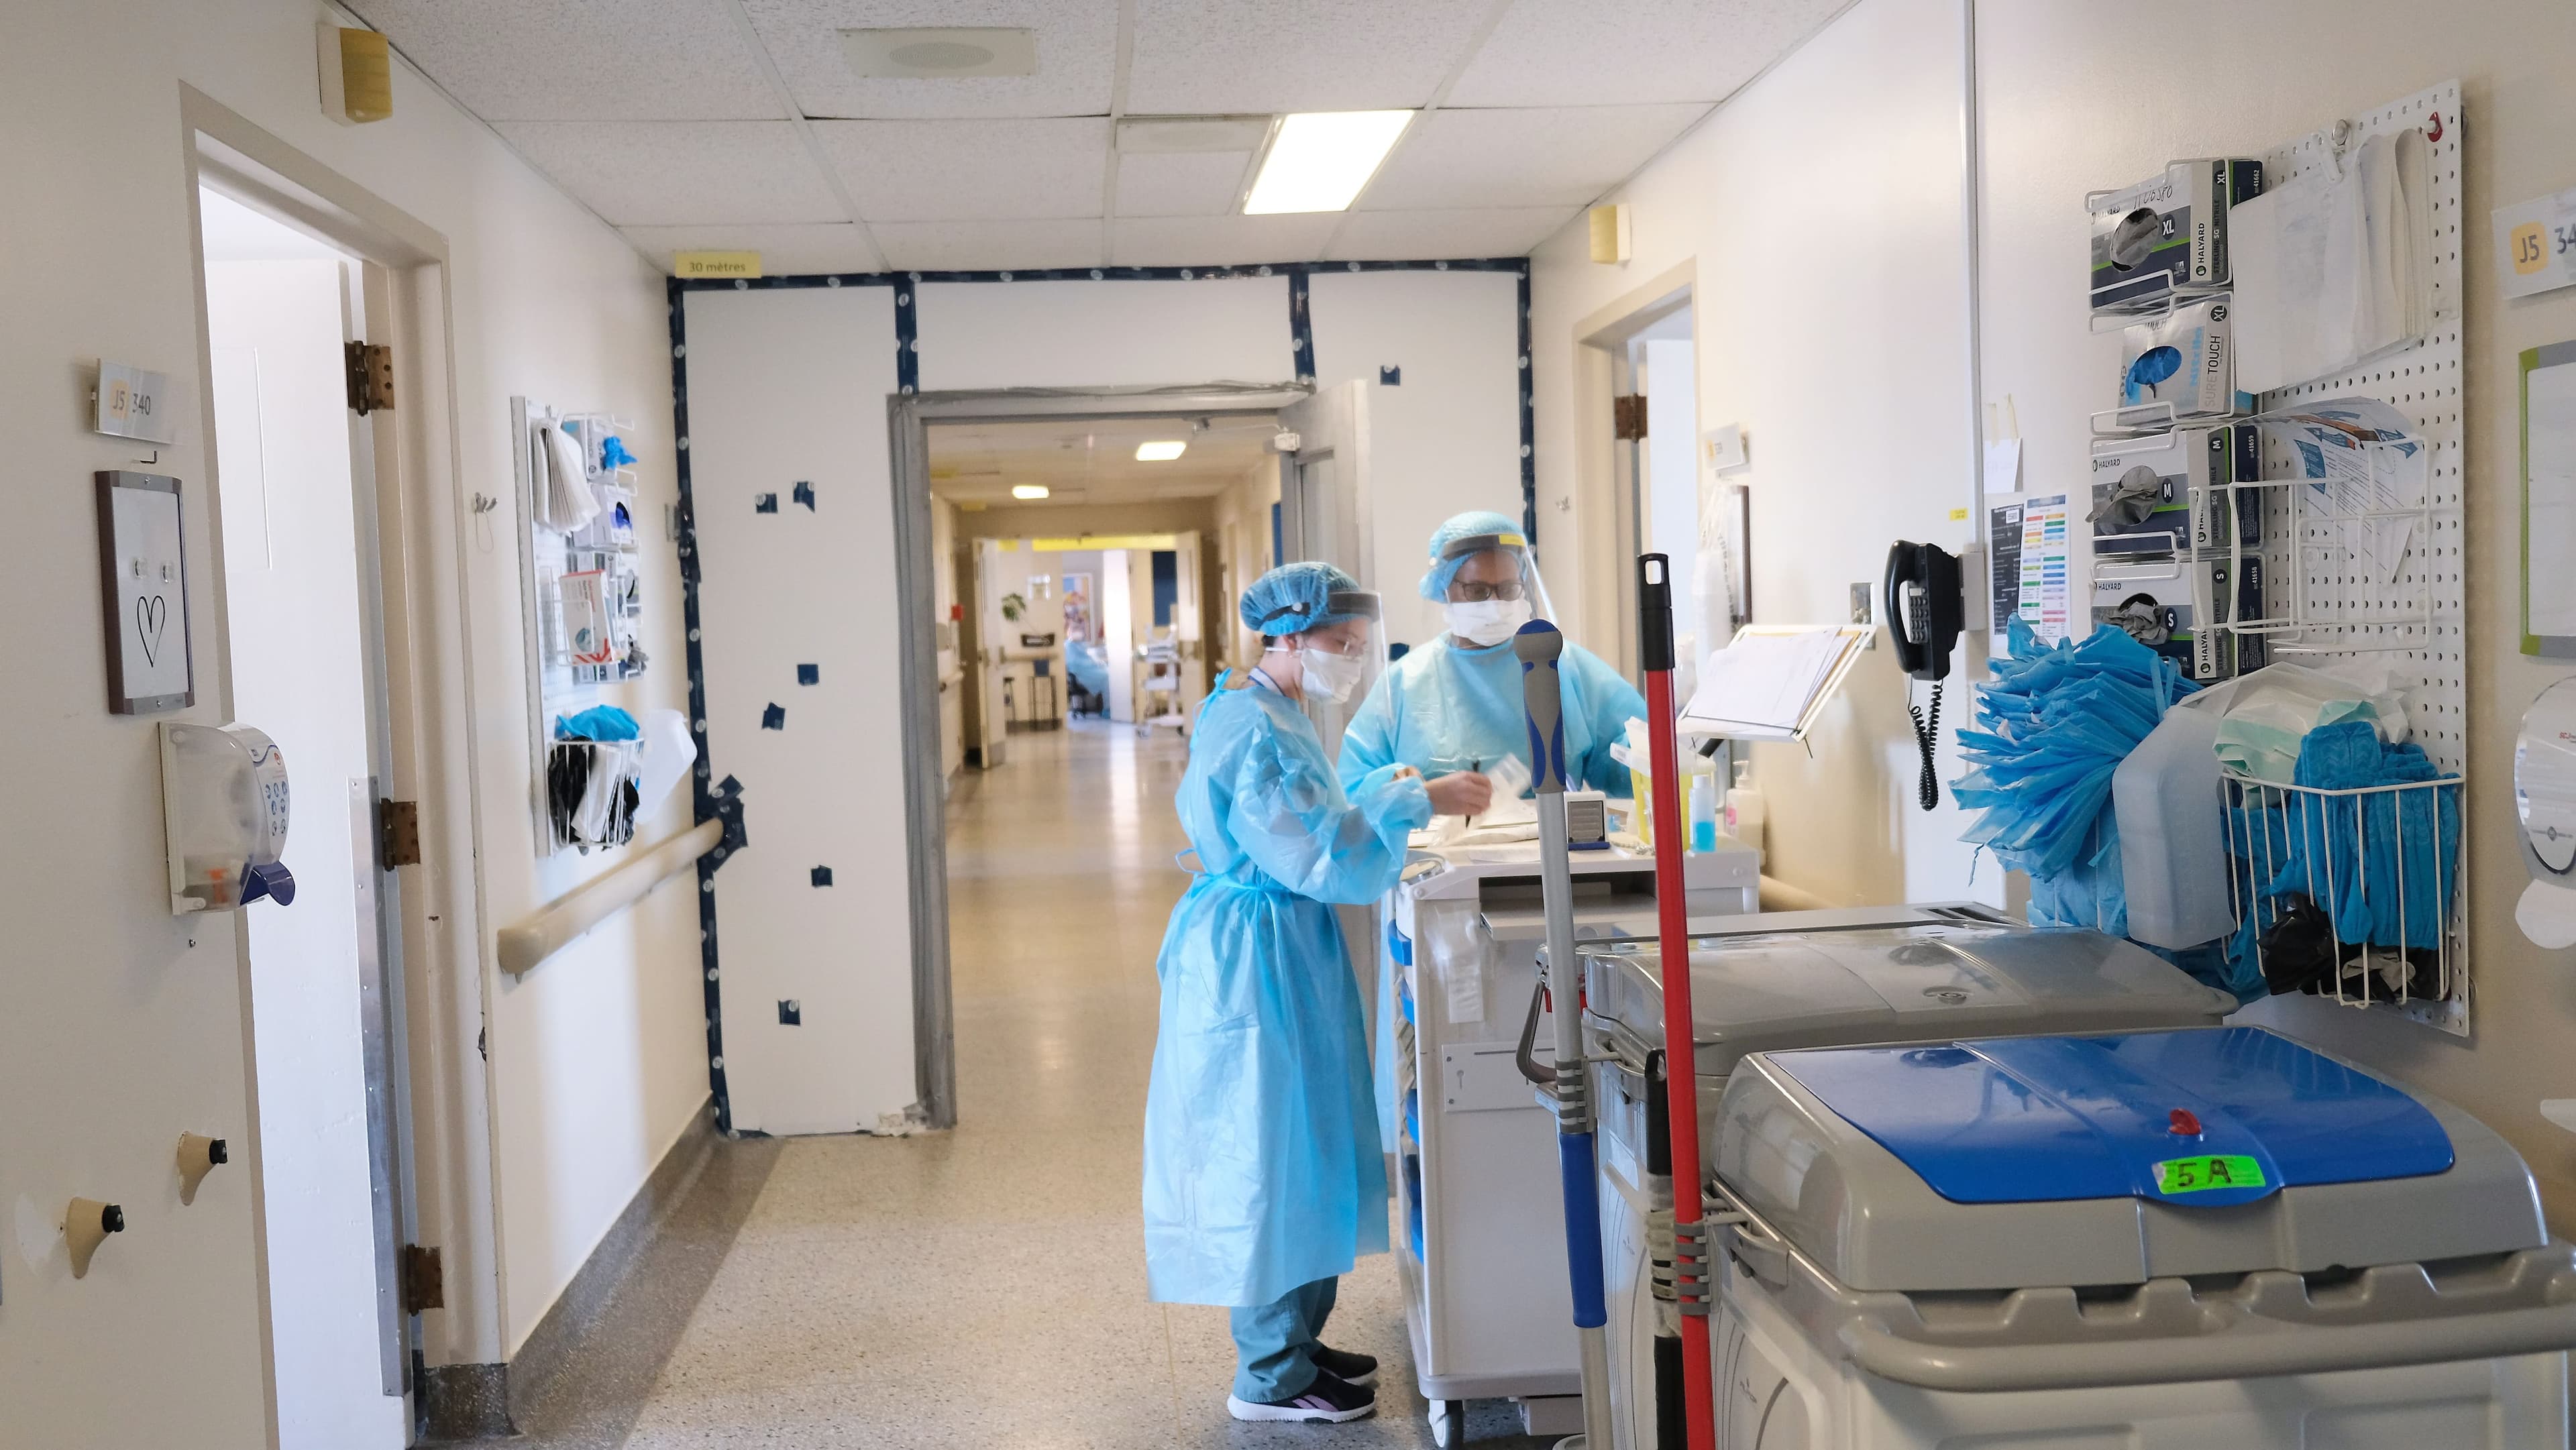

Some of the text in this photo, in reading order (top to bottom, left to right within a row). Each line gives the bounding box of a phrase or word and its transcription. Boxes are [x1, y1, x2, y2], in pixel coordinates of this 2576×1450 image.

[2217, 172, 2225, 184] XL
[2162, 220, 2175, 235] XL
[2520, 235, 2540, 263] J5
[689, 262, 702, 272] 30
[2213, 306, 2224, 321] XL
[113, 390, 151, 416] J5 340
[2212, 440, 2220, 449] M
[2098, 459, 2121, 469] HALYARD
[2163, 484, 2172, 498] M
[2098, 582, 2121, 590] HALYARD
[2167, 613, 2174, 626] S
[2178, 1158, 2231, 1187] 5 A
